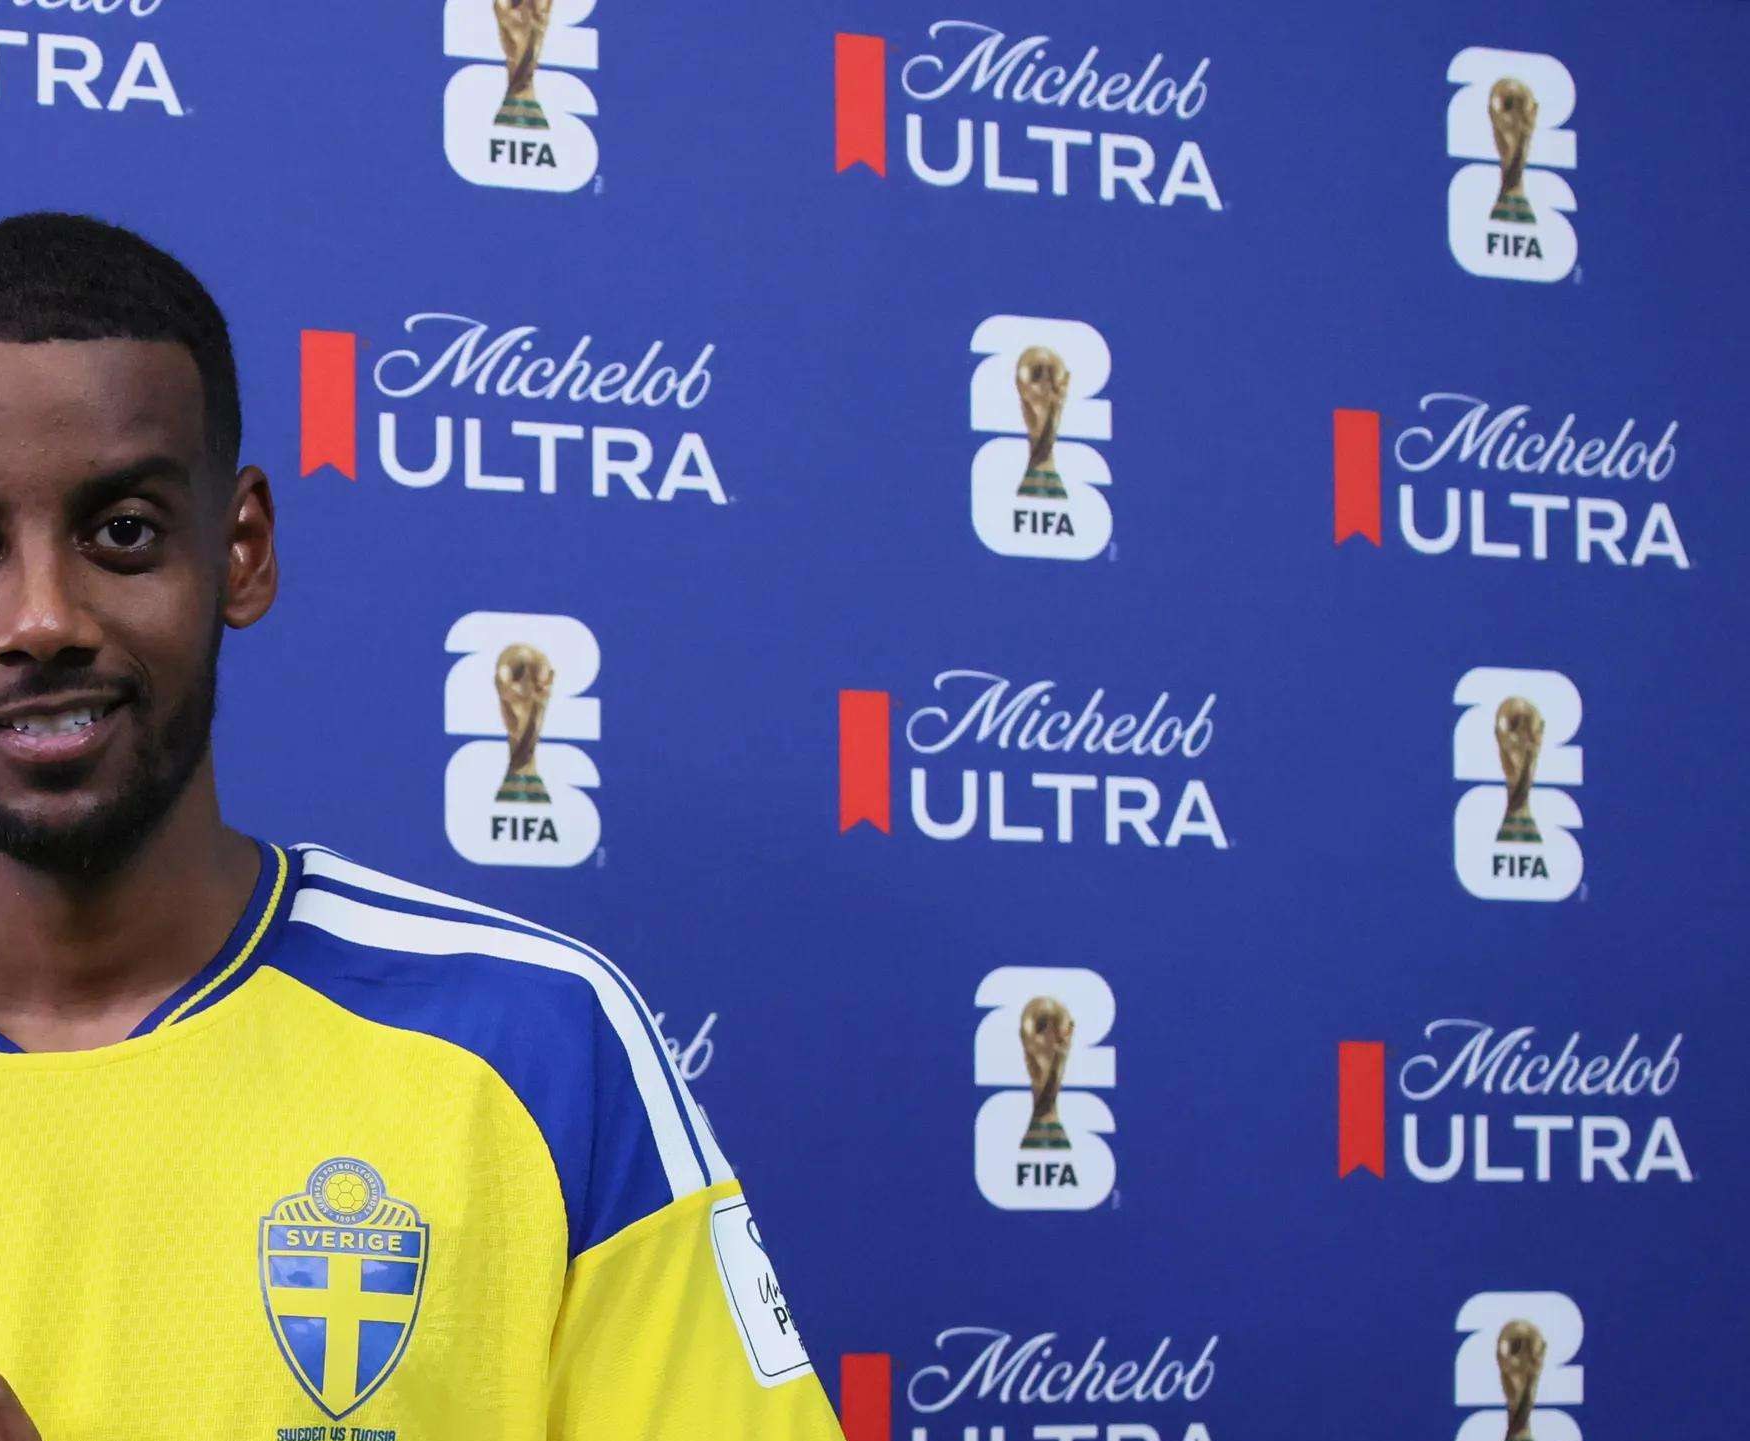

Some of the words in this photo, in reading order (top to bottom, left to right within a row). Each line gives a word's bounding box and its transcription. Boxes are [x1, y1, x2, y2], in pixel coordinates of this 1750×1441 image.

[902, 20, 1210, 119] Michelob
[491, 140, 556, 167] FIFA
[906, 113, 1222, 210] ULTRA
[1488, 233, 1542, 258] FIFA
[374, 313, 714, 408] Michelob
[379, 412, 727, 504] ULTRA
[1395, 393, 1678, 481] Michelob
[1014, 511, 1074, 535] FIFA
[1400, 484, 1689, 569] ULTRA
[906, 670, 1216, 757] Michelob
[492, 817, 558, 842] FIFA
[911, 768, 1228, 849] ULTRA
[1493, 855, 1548, 878] FIFA
[1400, 1019, 1682, 1100] Michelob
[1017, 1164, 1077, 1186] FIFA
[1404, 1114, 1693, 1182] ULTRA
[286, 1229, 403, 1253] SVERIGE
[908, 1327, 1218, 1412] Michelob
